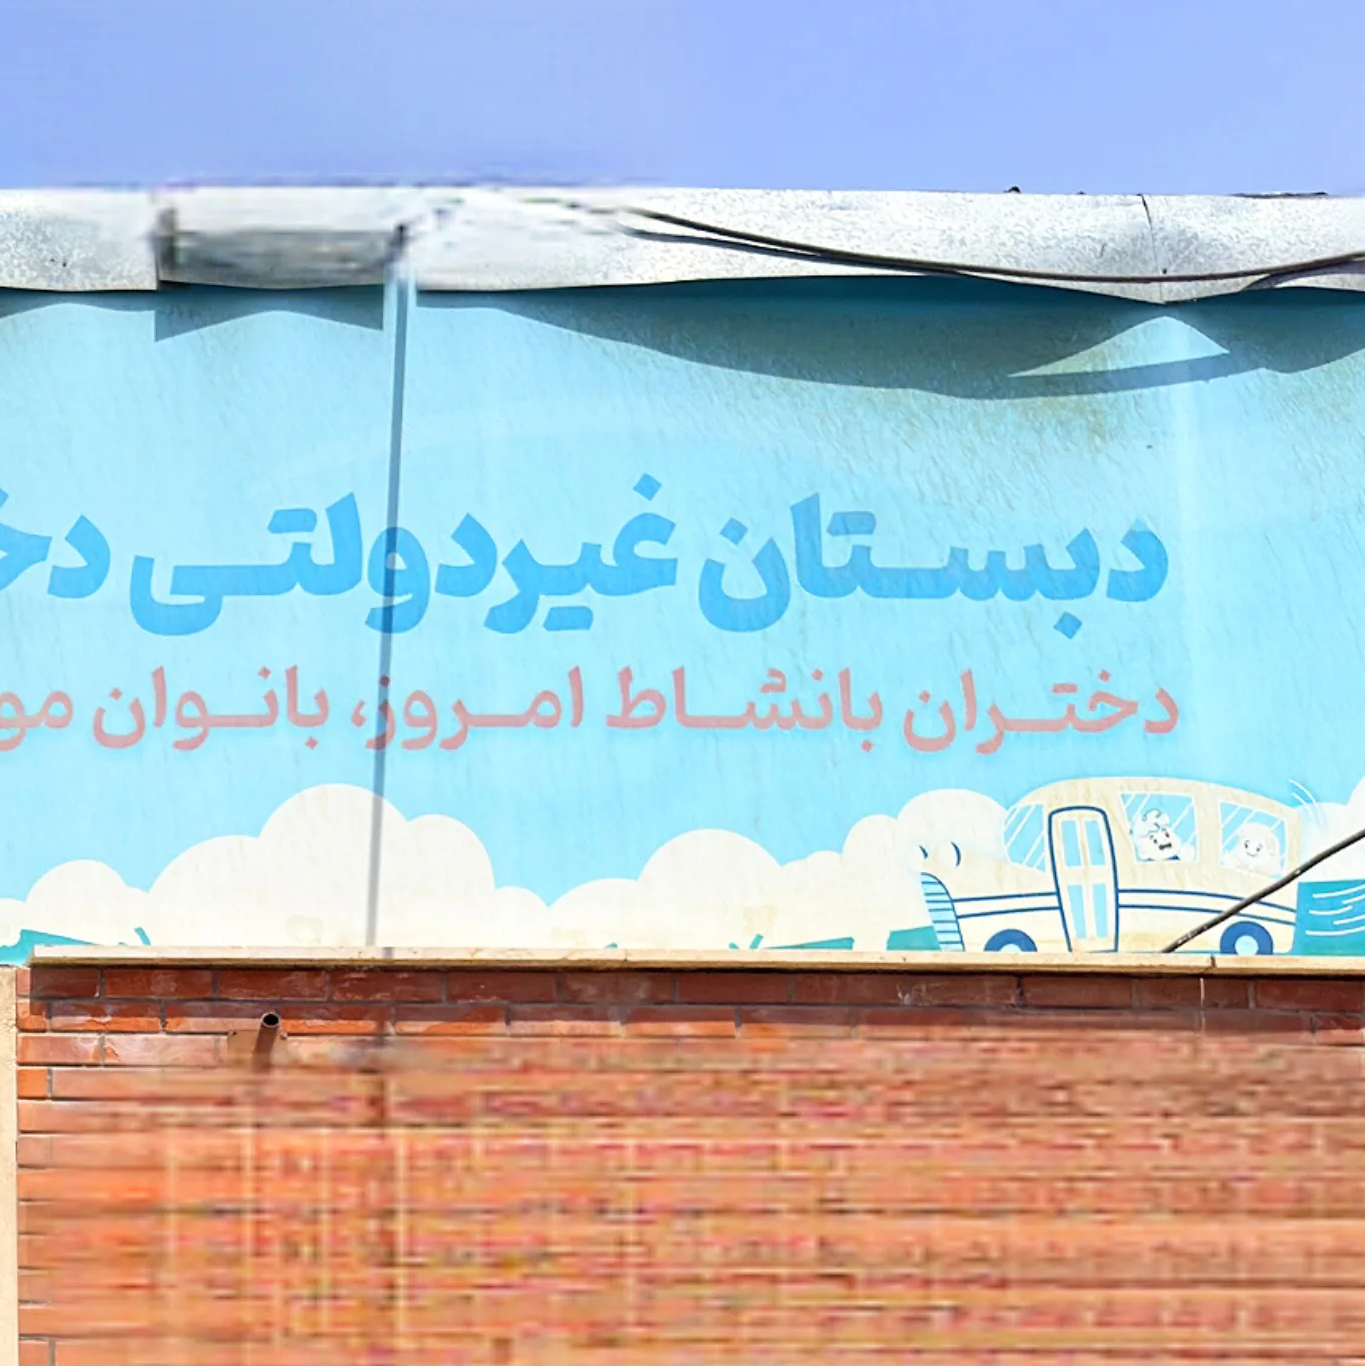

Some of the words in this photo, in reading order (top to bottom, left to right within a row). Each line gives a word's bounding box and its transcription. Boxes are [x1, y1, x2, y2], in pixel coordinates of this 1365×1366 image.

[698, 492, 1169, 640] دبستان
[92, 664, 330, 752] بانوان
[350, 666, 584, 751] امروز،
[605, 666, 884, 753] بانشاط
[903, 669, 1180, 755] دختران
